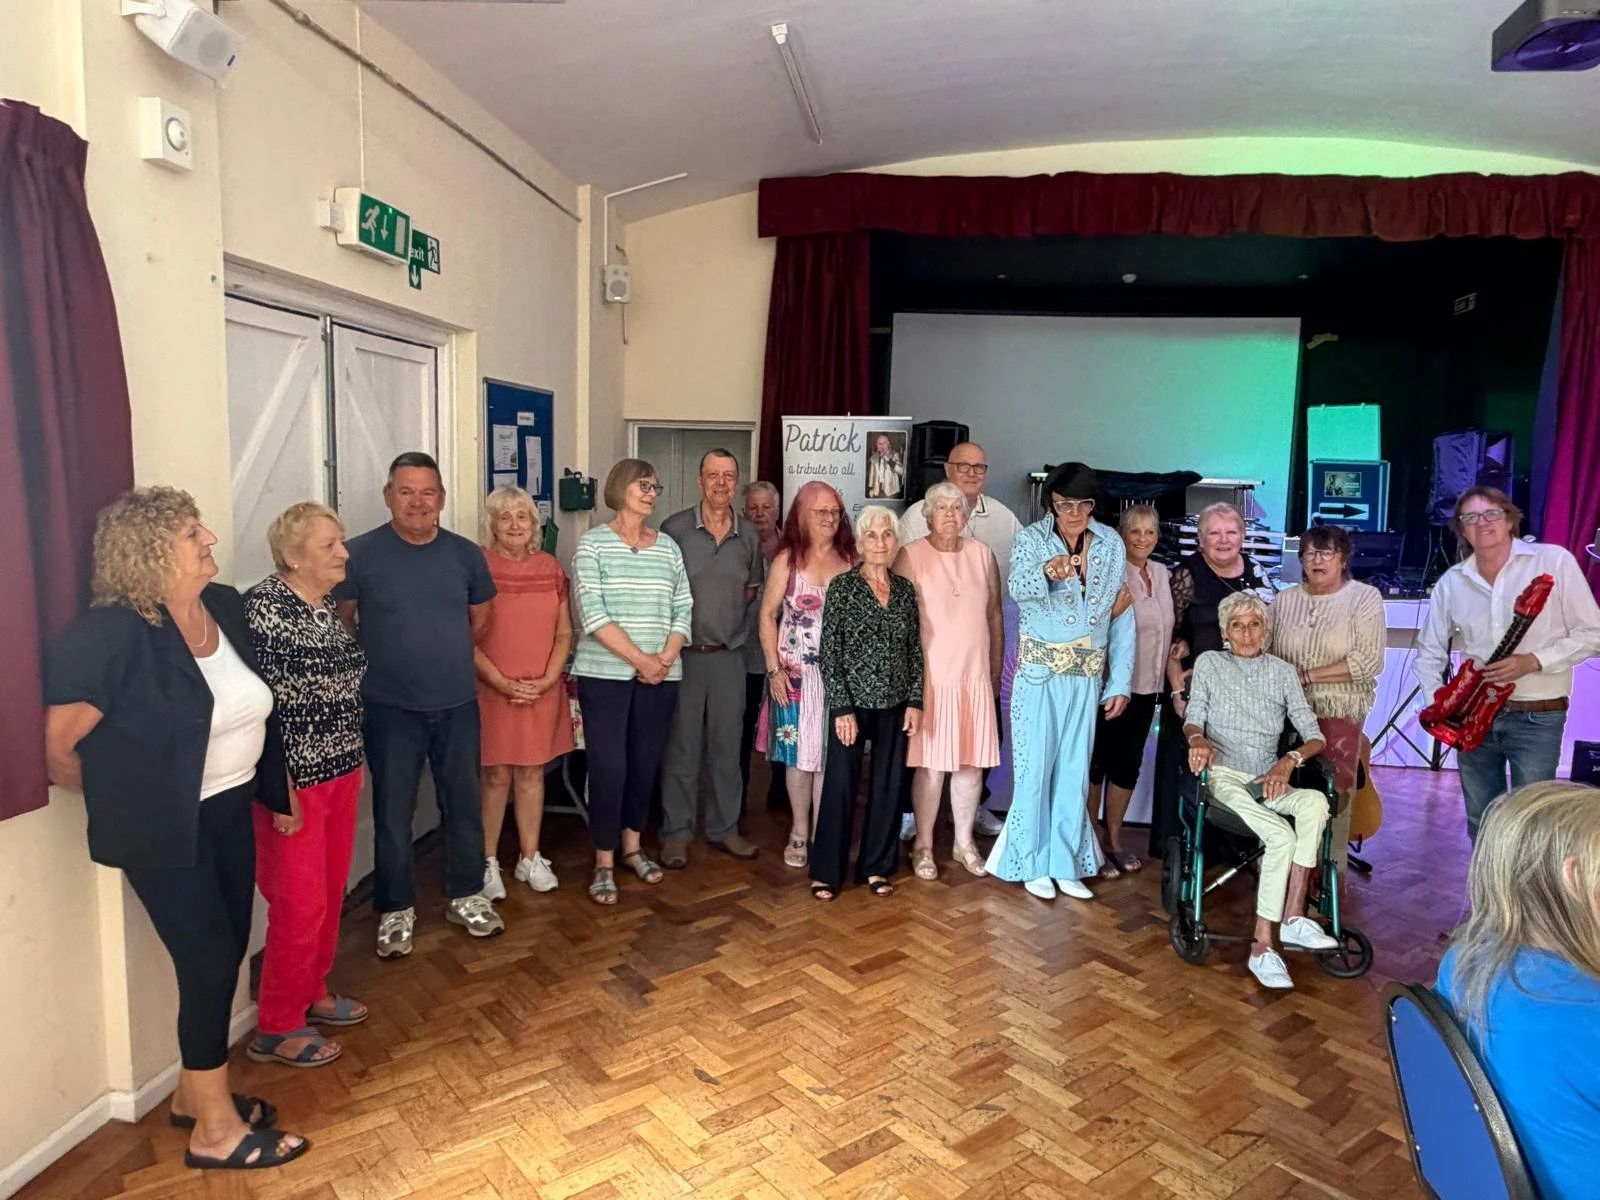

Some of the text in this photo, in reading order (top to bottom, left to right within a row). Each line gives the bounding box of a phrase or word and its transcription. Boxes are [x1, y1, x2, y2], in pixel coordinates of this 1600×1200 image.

[784, 422, 861, 453] Patrick
[788, 465, 796, 474] a
[796, 462, 827, 475] tribute
[829, 463, 838, 475] to
